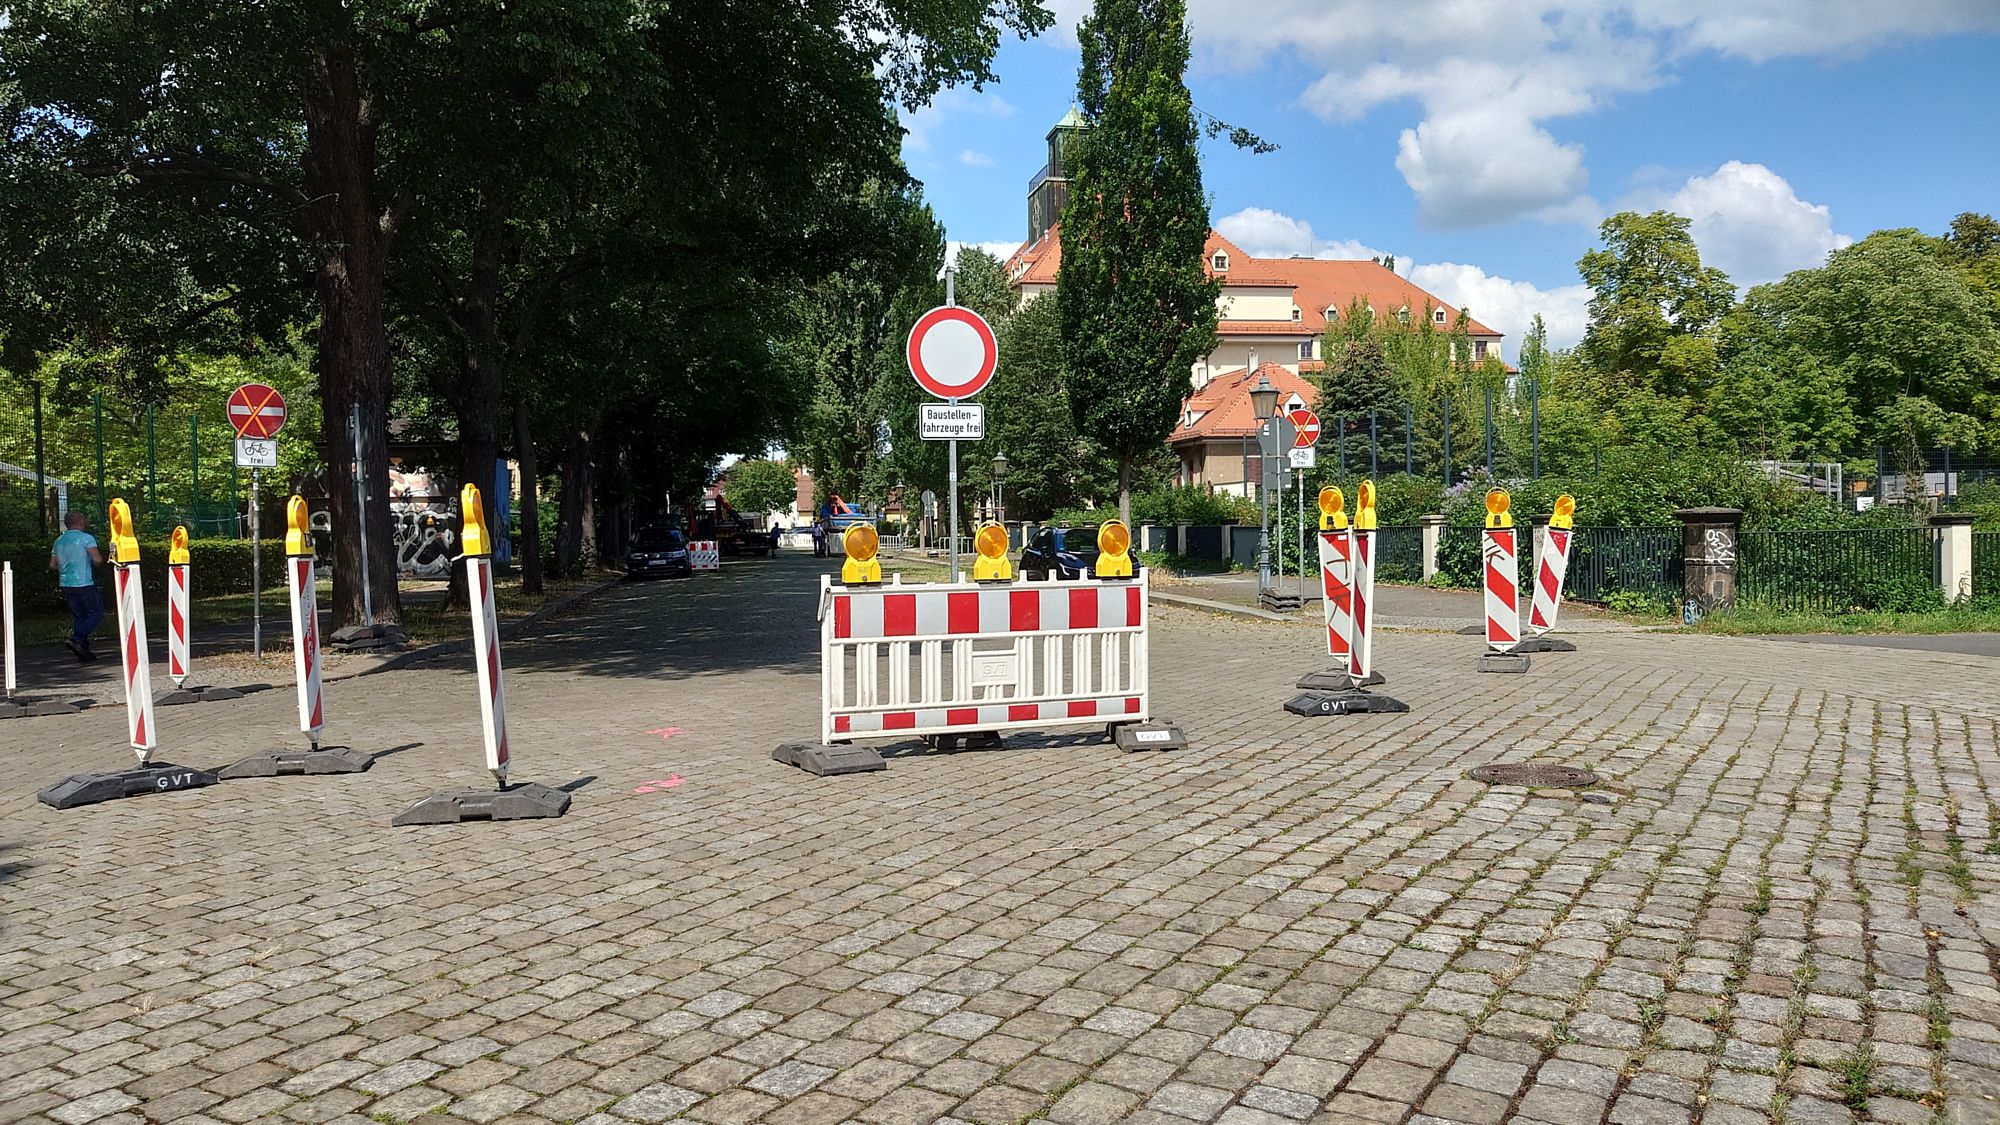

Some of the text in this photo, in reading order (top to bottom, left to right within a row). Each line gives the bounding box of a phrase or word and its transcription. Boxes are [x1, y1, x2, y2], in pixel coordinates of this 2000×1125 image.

[927, 409, 978, 420] Baustellen-
[923, 422, 981, 435] fahrzeuge frei
[250, 456, 264, 464] frei
[1321, 700, 1347, 711] GVT
[157, 772, 194, 789] GVT
